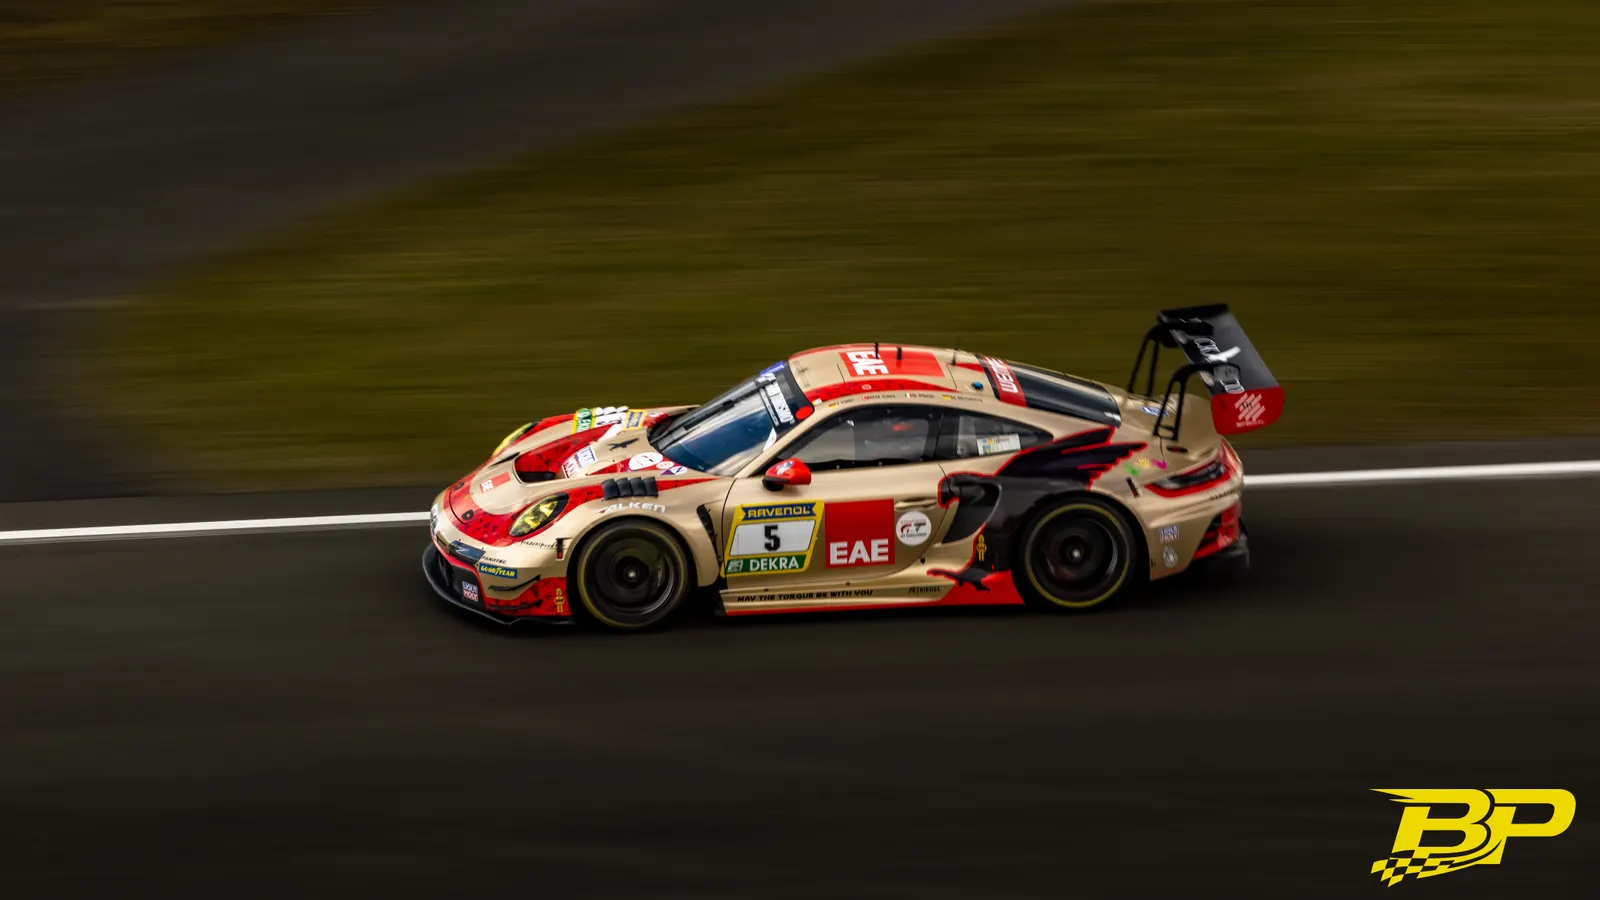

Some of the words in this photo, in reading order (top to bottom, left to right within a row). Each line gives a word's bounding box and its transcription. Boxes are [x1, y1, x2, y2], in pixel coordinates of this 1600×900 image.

[846, 351, 890, 376] EAE
[747, 506, 811, 518] RAVENOL
[764, 524, 781, 552] 5
[829, 538, 889, 565] EAE
[480, 565, 515, 577] GOODYEAR
[749, 555, 799, 573] DEKRA
[760, 594, 776, 602] THE
[778, 592, 814, 600] TORQUE
[830, 590, 852, 598] WITH
[854, 589, 874, 597] YOU
